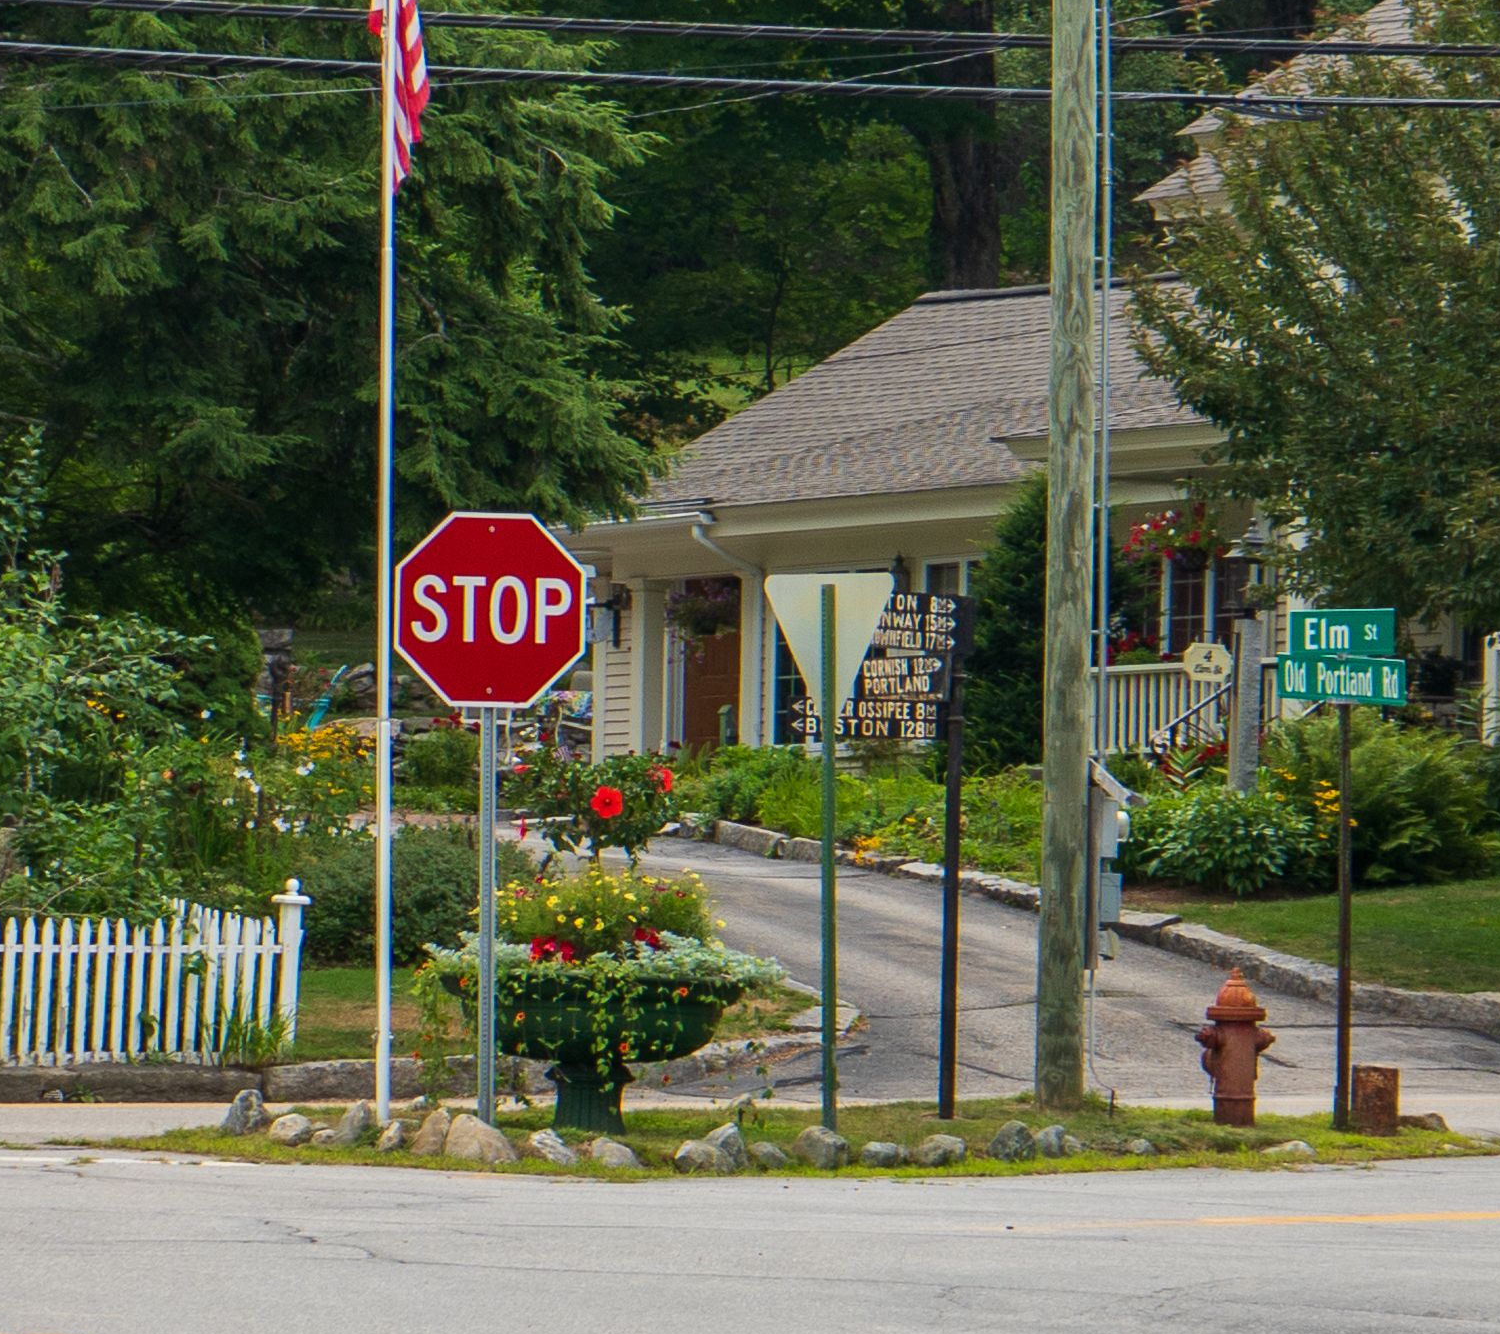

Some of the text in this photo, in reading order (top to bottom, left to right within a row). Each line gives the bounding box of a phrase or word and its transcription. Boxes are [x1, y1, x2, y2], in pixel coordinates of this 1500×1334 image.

[410, 574, 573, 645] STOP
[887, 593, 918, 611] TON
[881, 612, 922, 630] NWAY
[872, 629, 922, 648] OWNFIELD
[1304, 617, 1378, 650] Elm St
[1203, 650, 1213, 663] 4
[863, 658, 908, 678] CORNISH
[864, 675, 930, 695] PORTLAND
[1284, 659, 1399, 699] Old Portland Rd
[858, 701, 911, 720] OSSIPEE
[805, 717, 889, 737] BSTON
